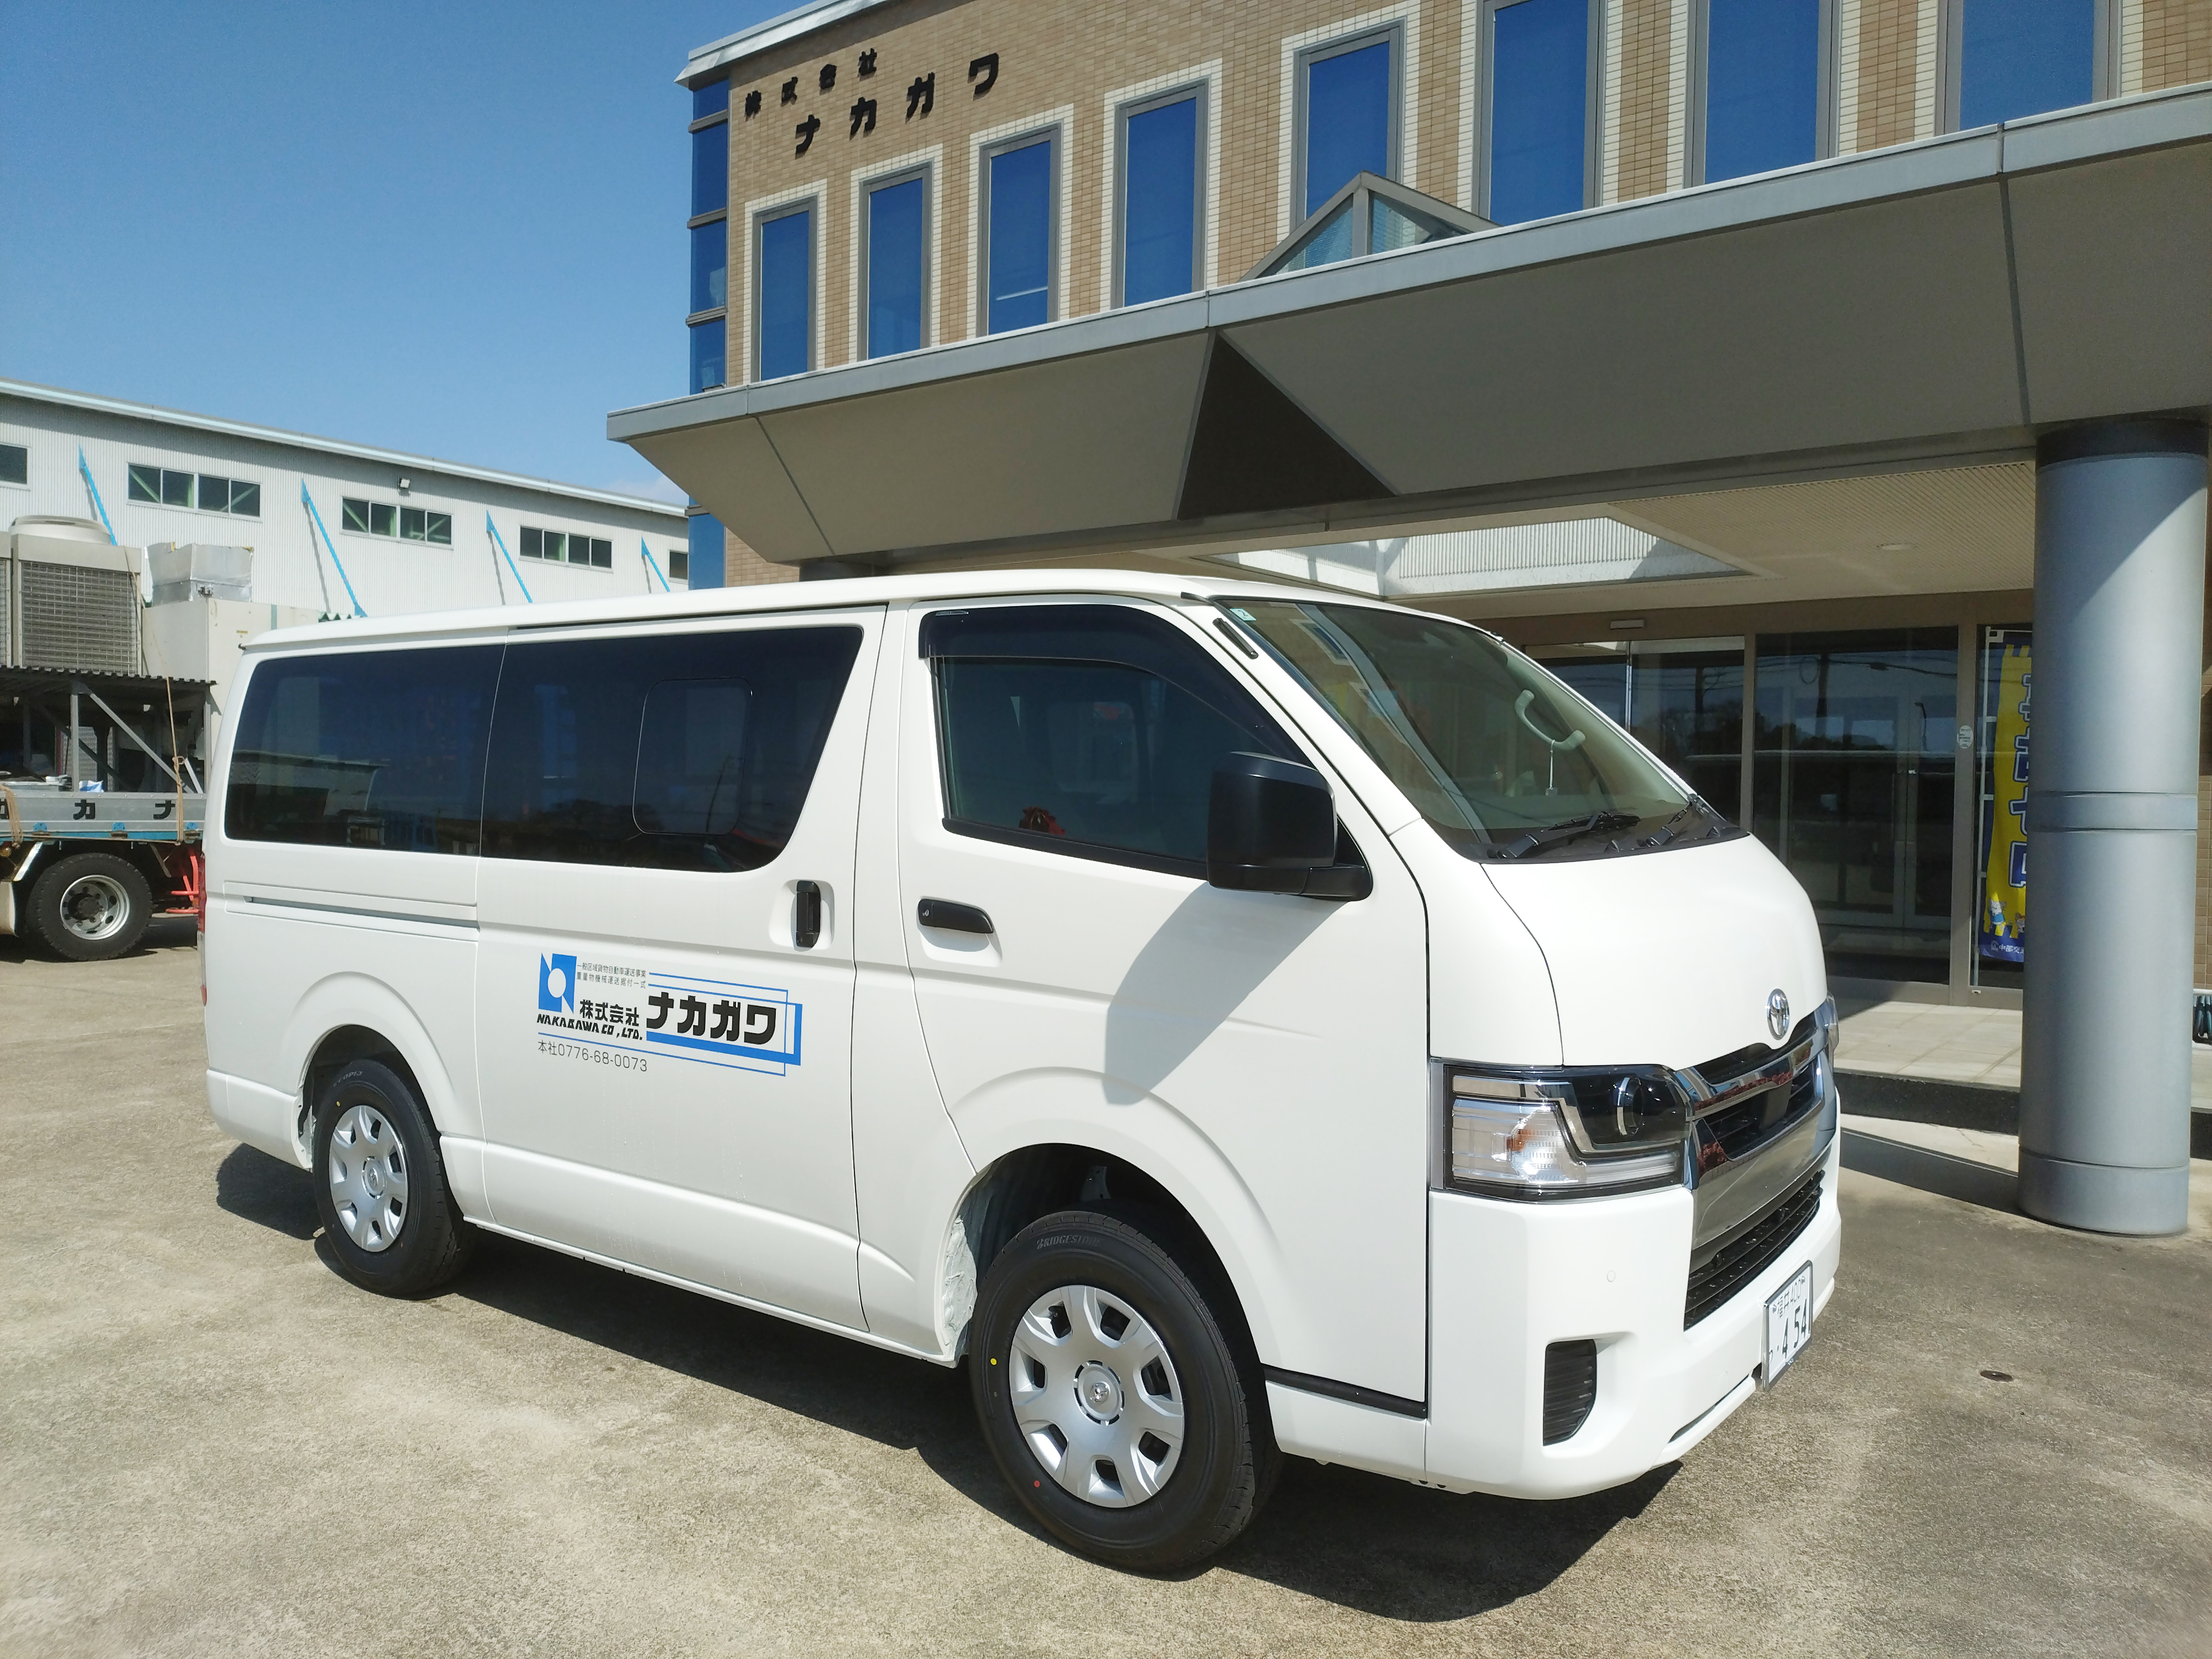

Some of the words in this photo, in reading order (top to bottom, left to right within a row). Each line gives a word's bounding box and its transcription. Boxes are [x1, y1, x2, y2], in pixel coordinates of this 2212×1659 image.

[745, 48, 877, 117] 株式会社
[796, 53, 999, 155] ナカガワ
[580, 999, 640, 1027] 株式会社
[646, 992, 776, 1045] ナカガワ
